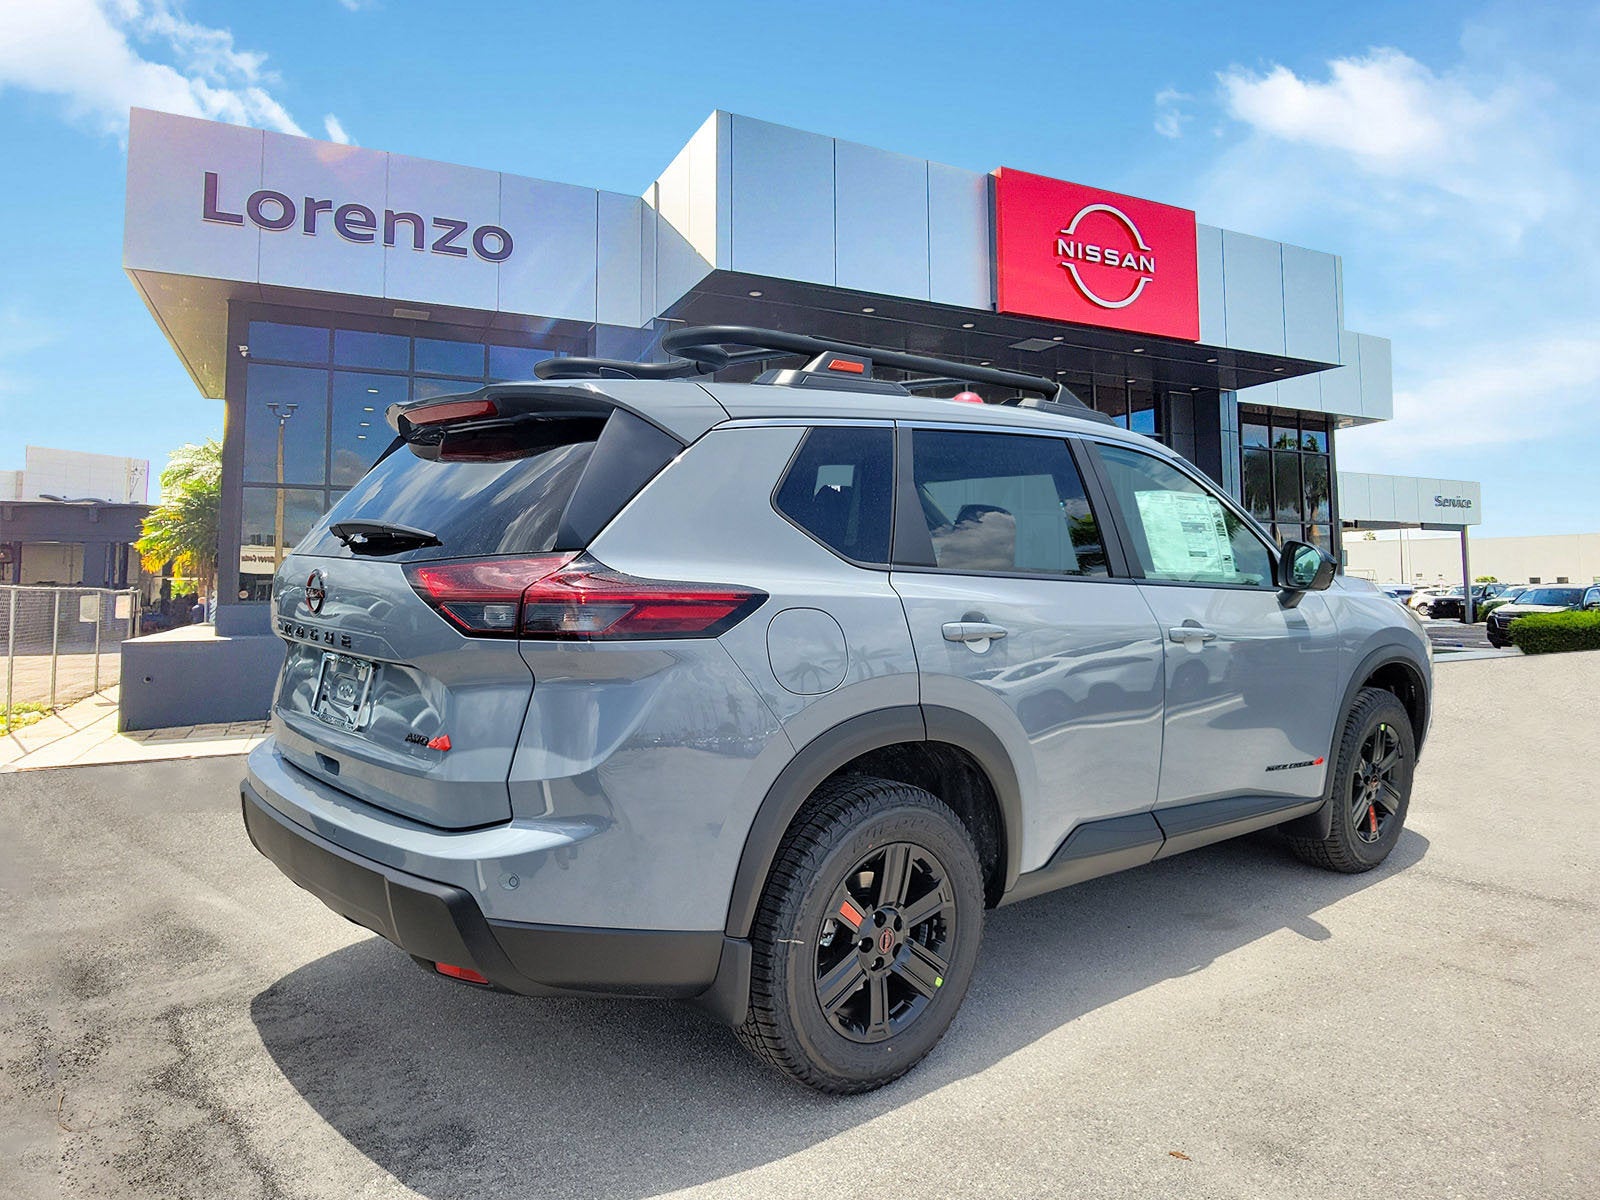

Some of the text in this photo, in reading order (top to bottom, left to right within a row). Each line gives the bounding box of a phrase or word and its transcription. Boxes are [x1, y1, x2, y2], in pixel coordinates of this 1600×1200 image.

[202, 171, 514, 262] Lorenzo
[1057, 237, 1156, 274] NISSAN
[1434, 495, 1472, 508] Service
